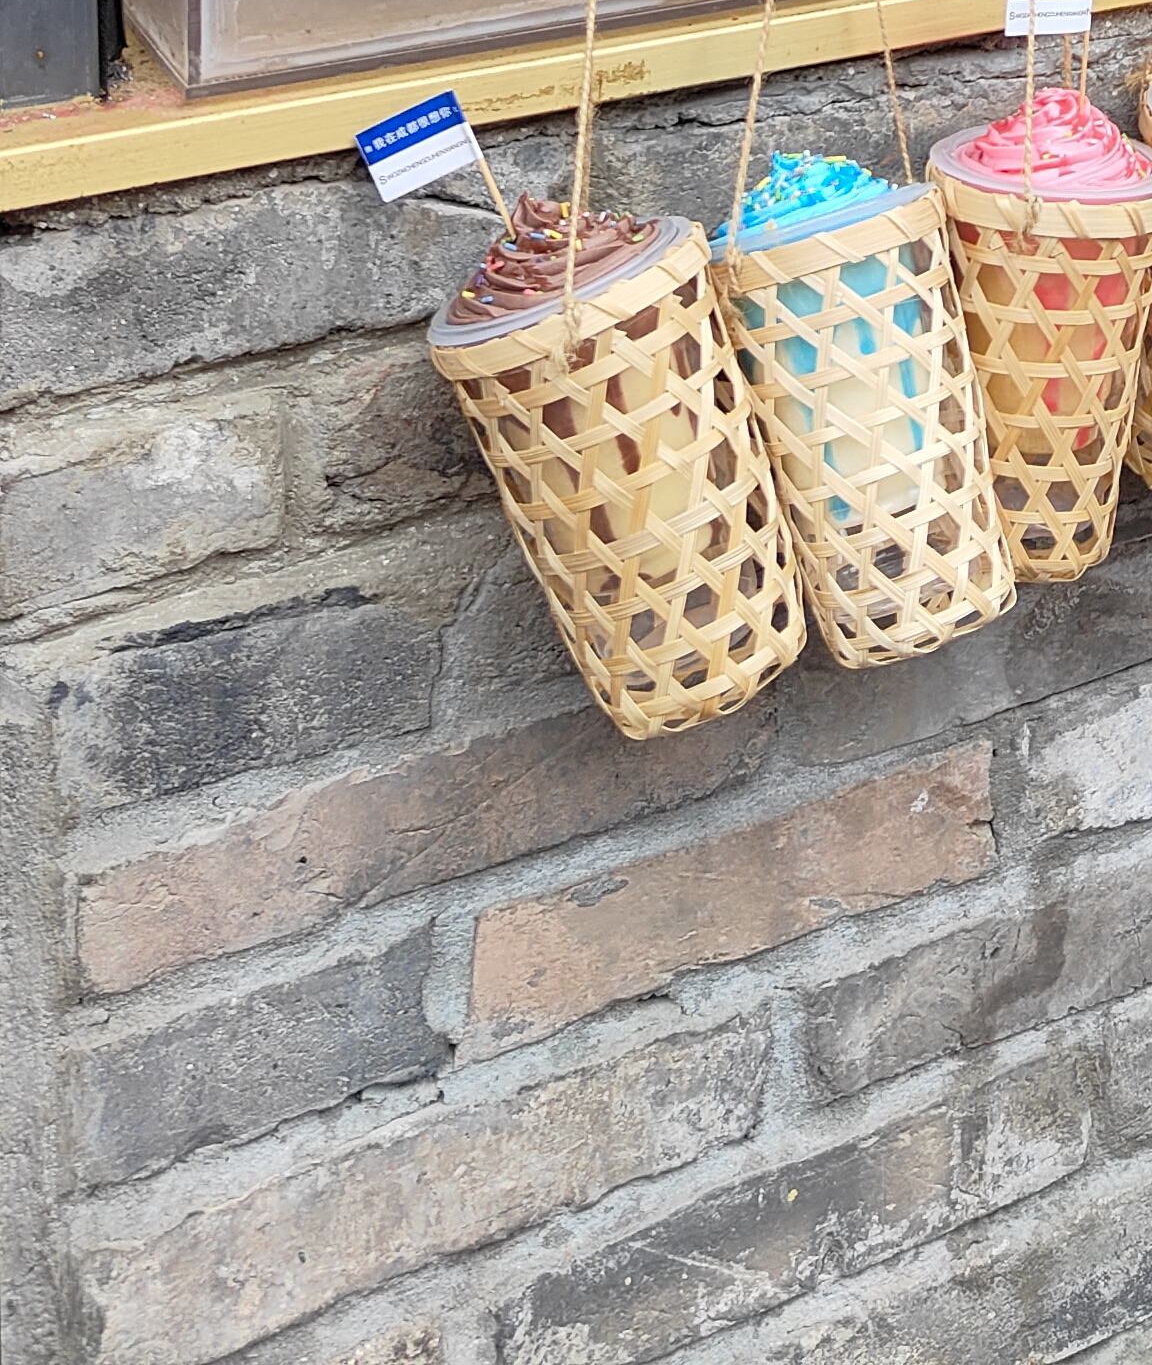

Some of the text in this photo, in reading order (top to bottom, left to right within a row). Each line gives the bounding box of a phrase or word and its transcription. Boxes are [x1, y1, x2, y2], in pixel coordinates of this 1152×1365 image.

[372, 106, 453, 151] 我在成都很想你
